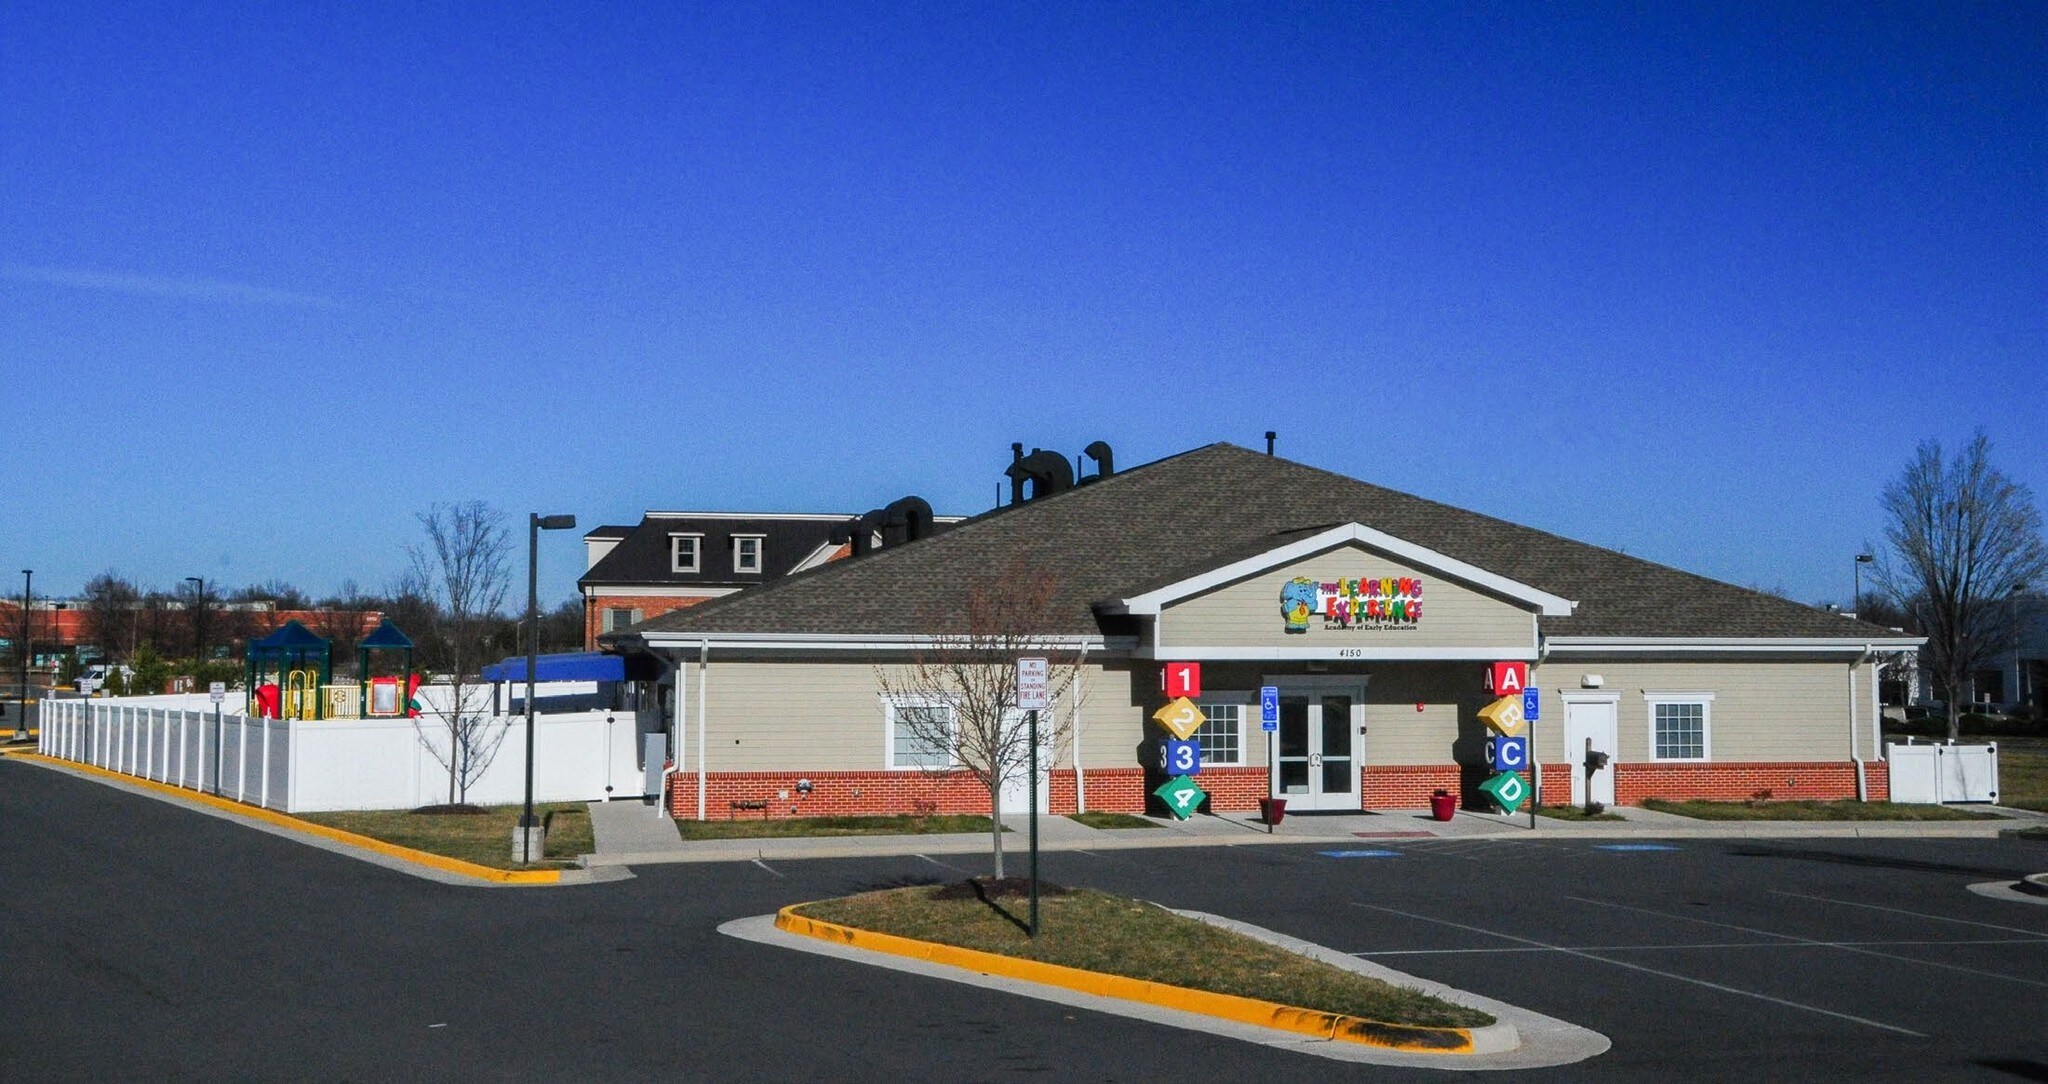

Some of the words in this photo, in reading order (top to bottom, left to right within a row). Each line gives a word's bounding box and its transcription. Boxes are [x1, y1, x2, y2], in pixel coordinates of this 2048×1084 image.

[1321, 583, 1339, 594] THE
[1324, 624, 1356, 632] Academy
[1364, 624, 1382, 632] Early
[1340, 648, 1361, 657] 4150
[1178, 668, 1190, 691] 1
[1484, 667, 1494, 690] A
[1502, 667, 1521, 690] A
[1020, 691, 1031, 699] FIRE
[1032, 691, 1046, 699] LANE
[1171, 708, 1195, 732] 2
[1499, 704, 1523, 728] B
[1160, 745, 1167, 769] 3
[1176, 745, 1194, 770] 3
[1485, 741, 1495, 764] C
[1502, 741, 1521, 766] C
[1173, 788, 1196, 809] 4
[1498, 777, 1522, 801] D
